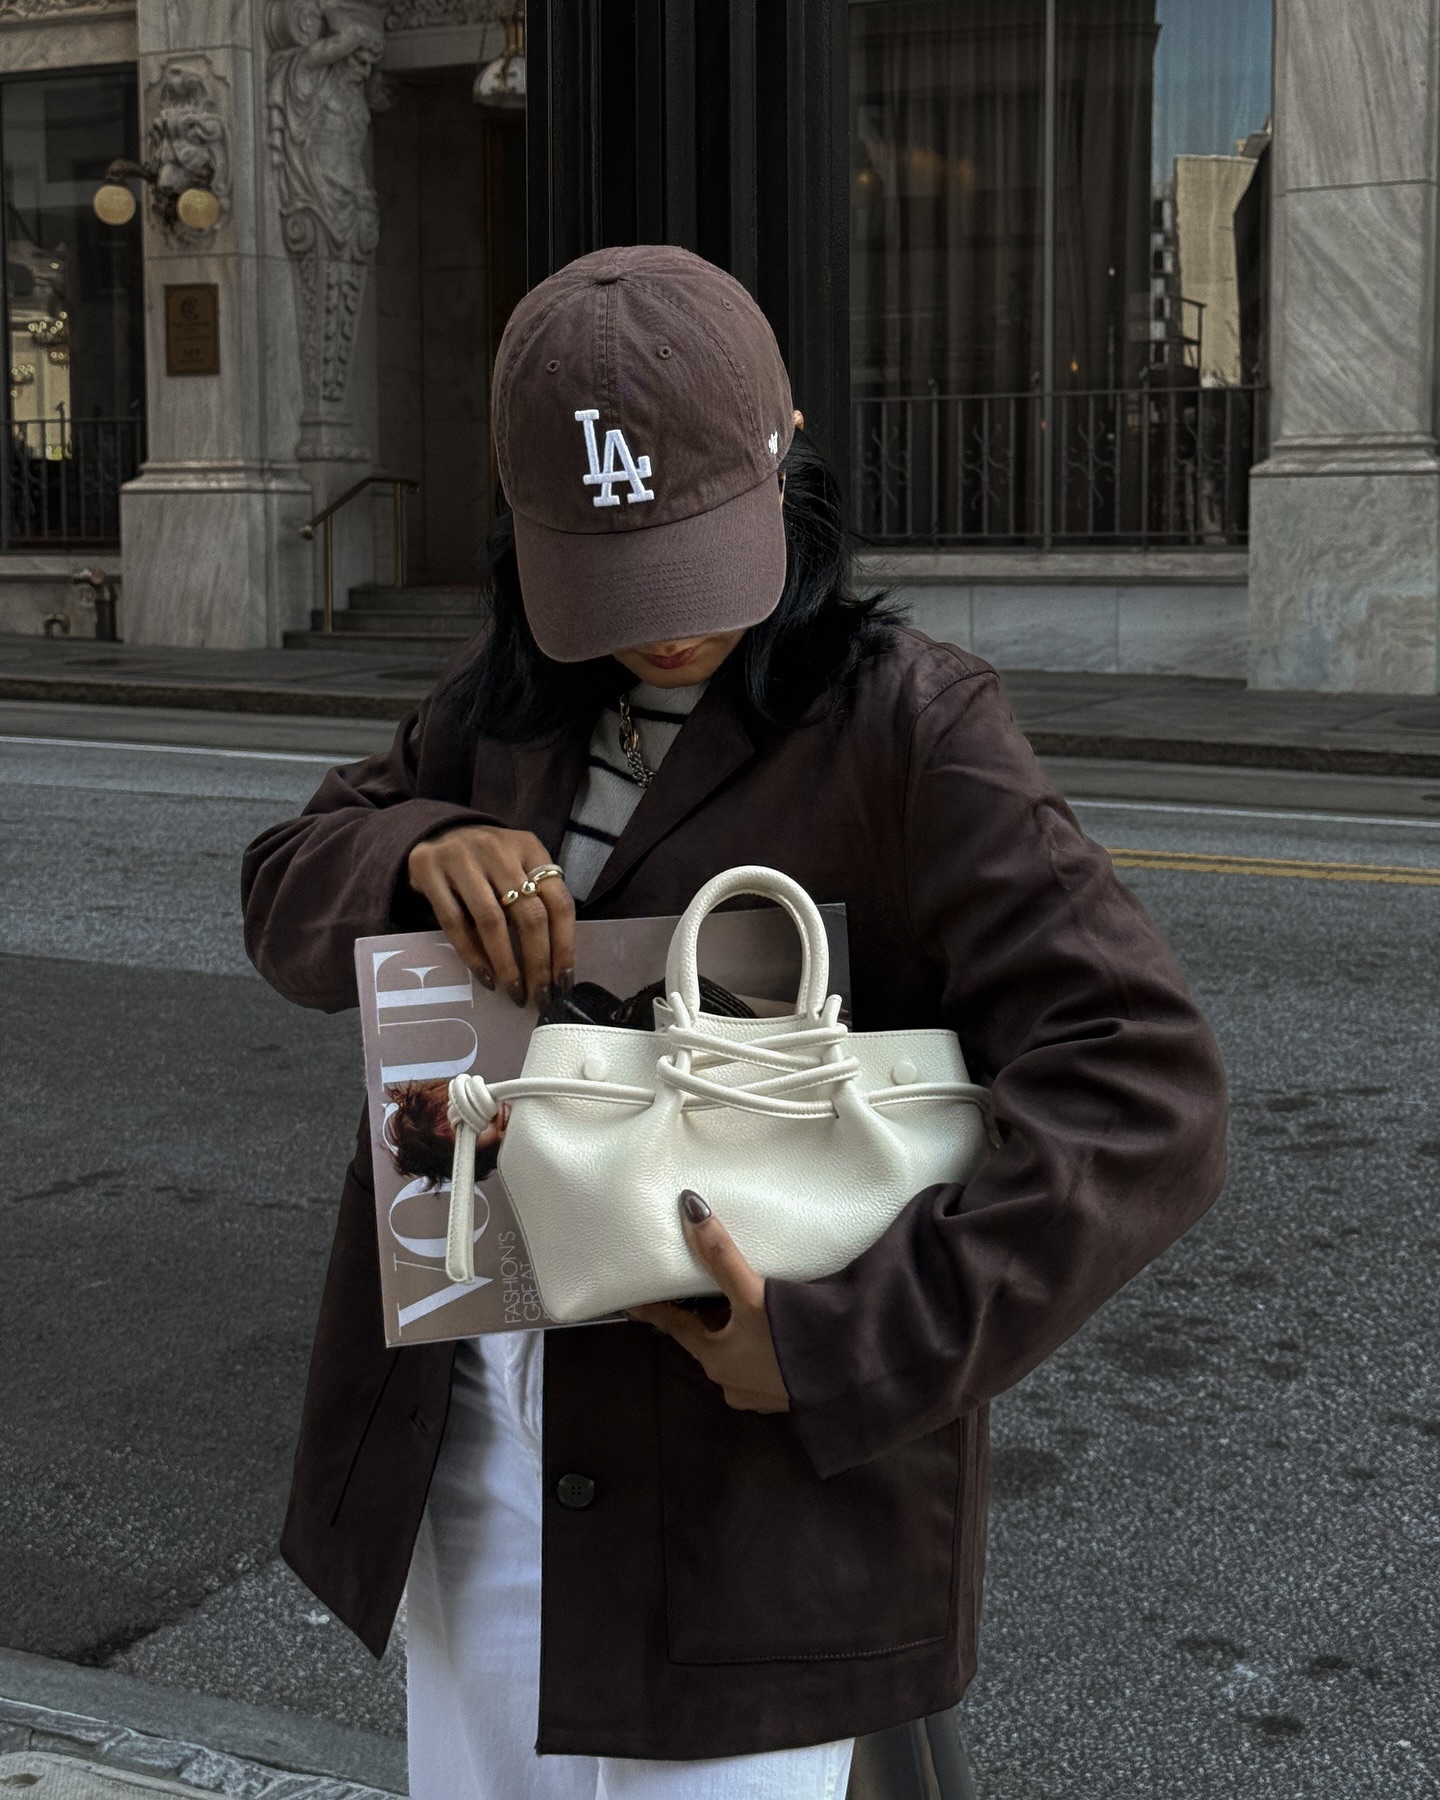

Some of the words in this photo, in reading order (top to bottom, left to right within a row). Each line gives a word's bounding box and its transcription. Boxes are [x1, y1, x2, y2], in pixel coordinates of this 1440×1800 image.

[574, 409, 655, 507] LA
[372, 943, 494, 1336] VOUE
[498, 1230, 521, 1324] FASHION'S
